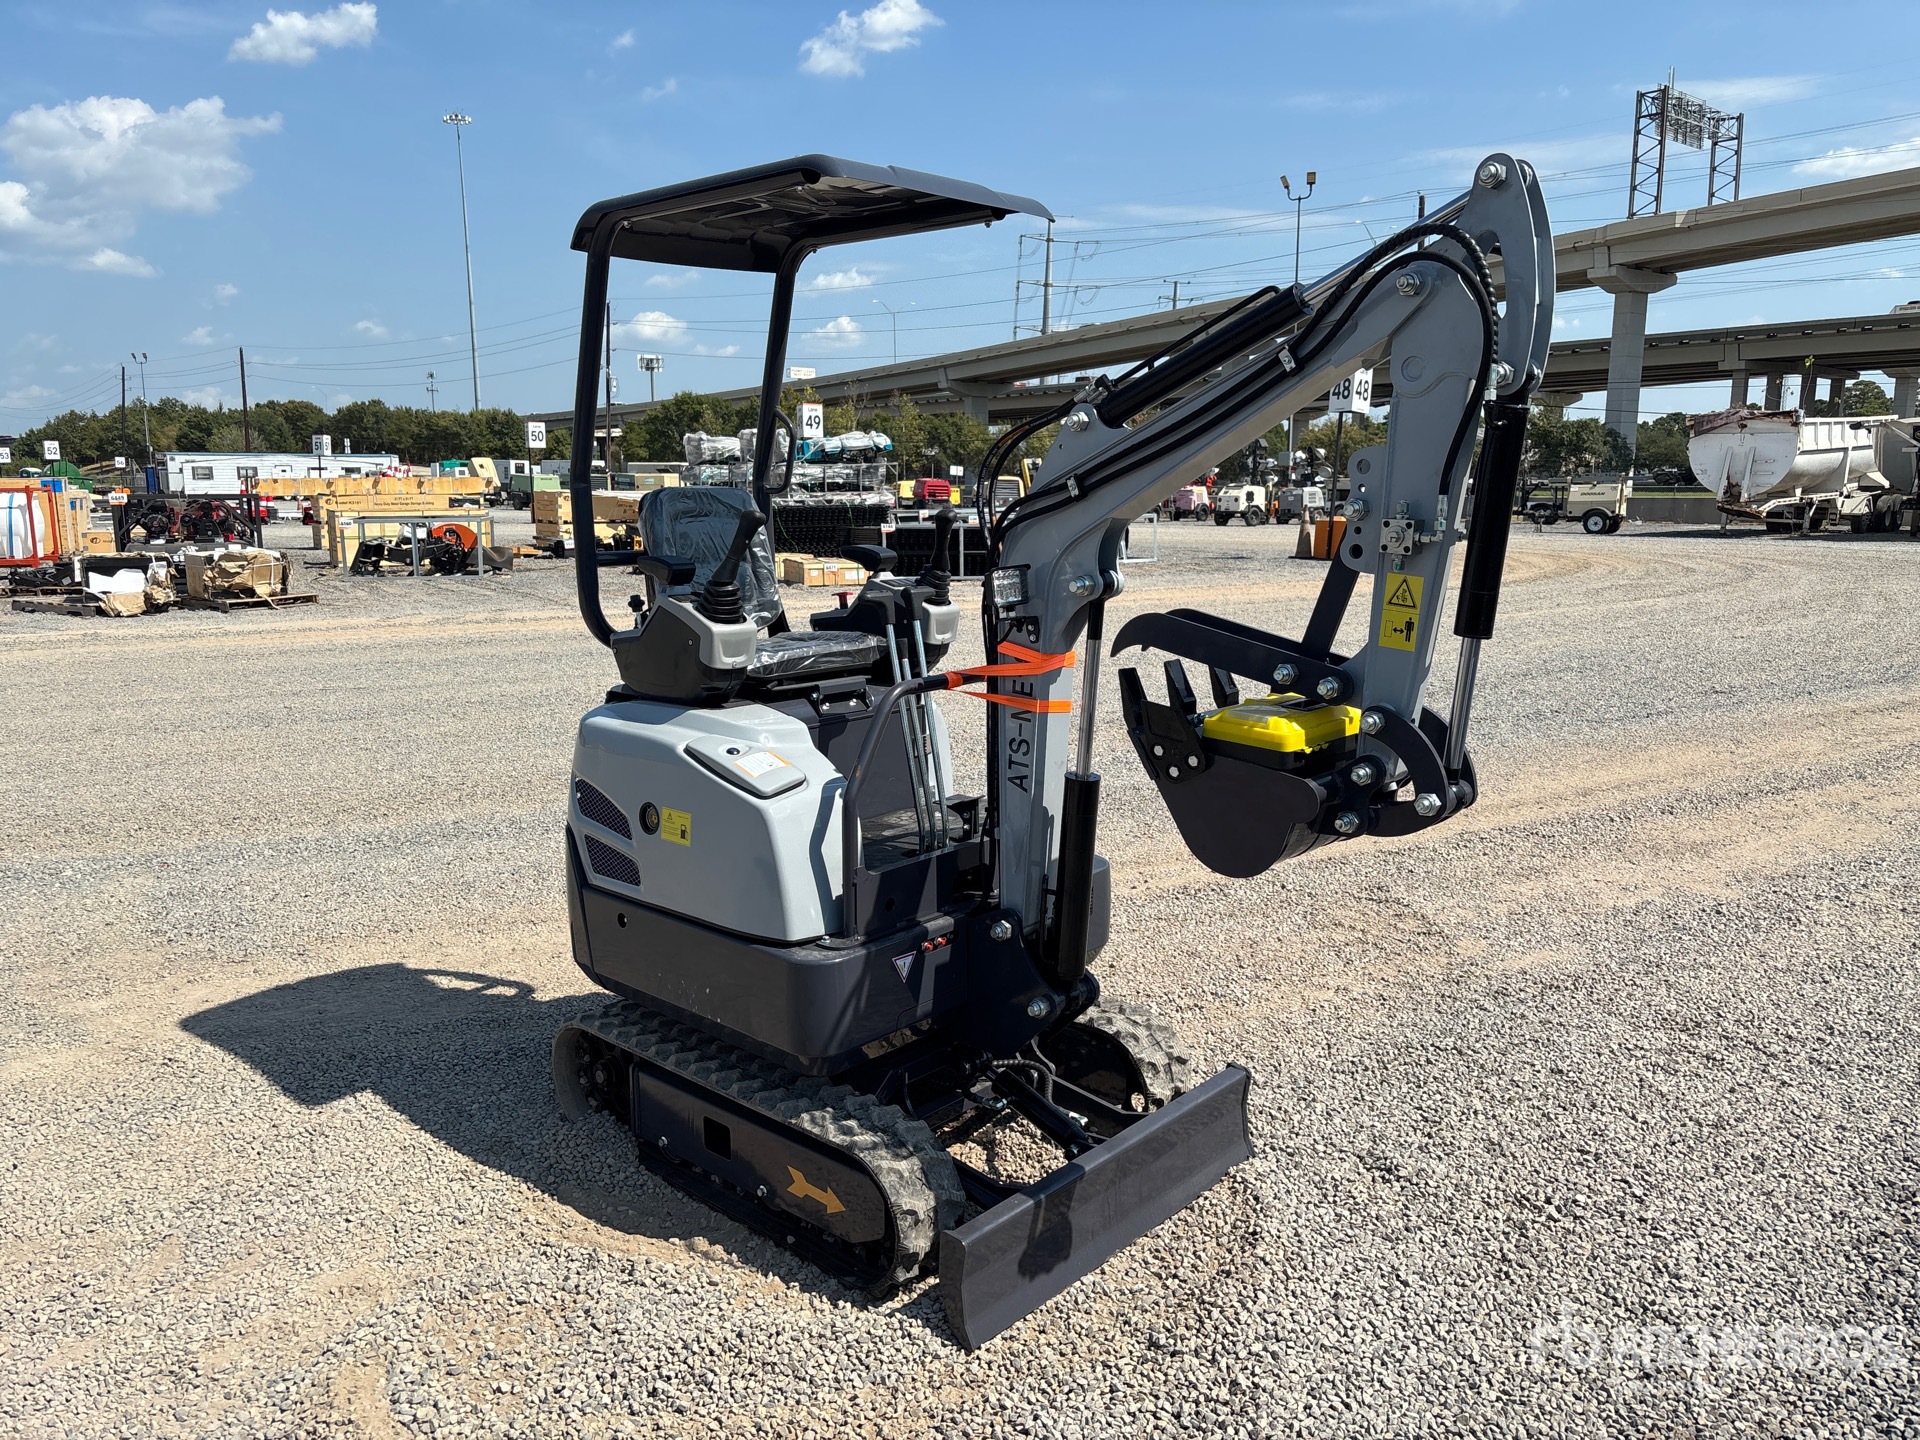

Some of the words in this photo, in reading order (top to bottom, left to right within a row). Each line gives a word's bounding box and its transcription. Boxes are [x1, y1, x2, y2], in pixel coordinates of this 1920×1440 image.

[1332, 378, 1351, 400] 48
[1355, 379, 1369, 401] 48
[805, 415, 821, 429] 49
[531, 430, 544, 442] 50
[47, 447, 58, 455] 52
[314, 441, 322, 451] 51
[0, 452, 9, 460] 53
